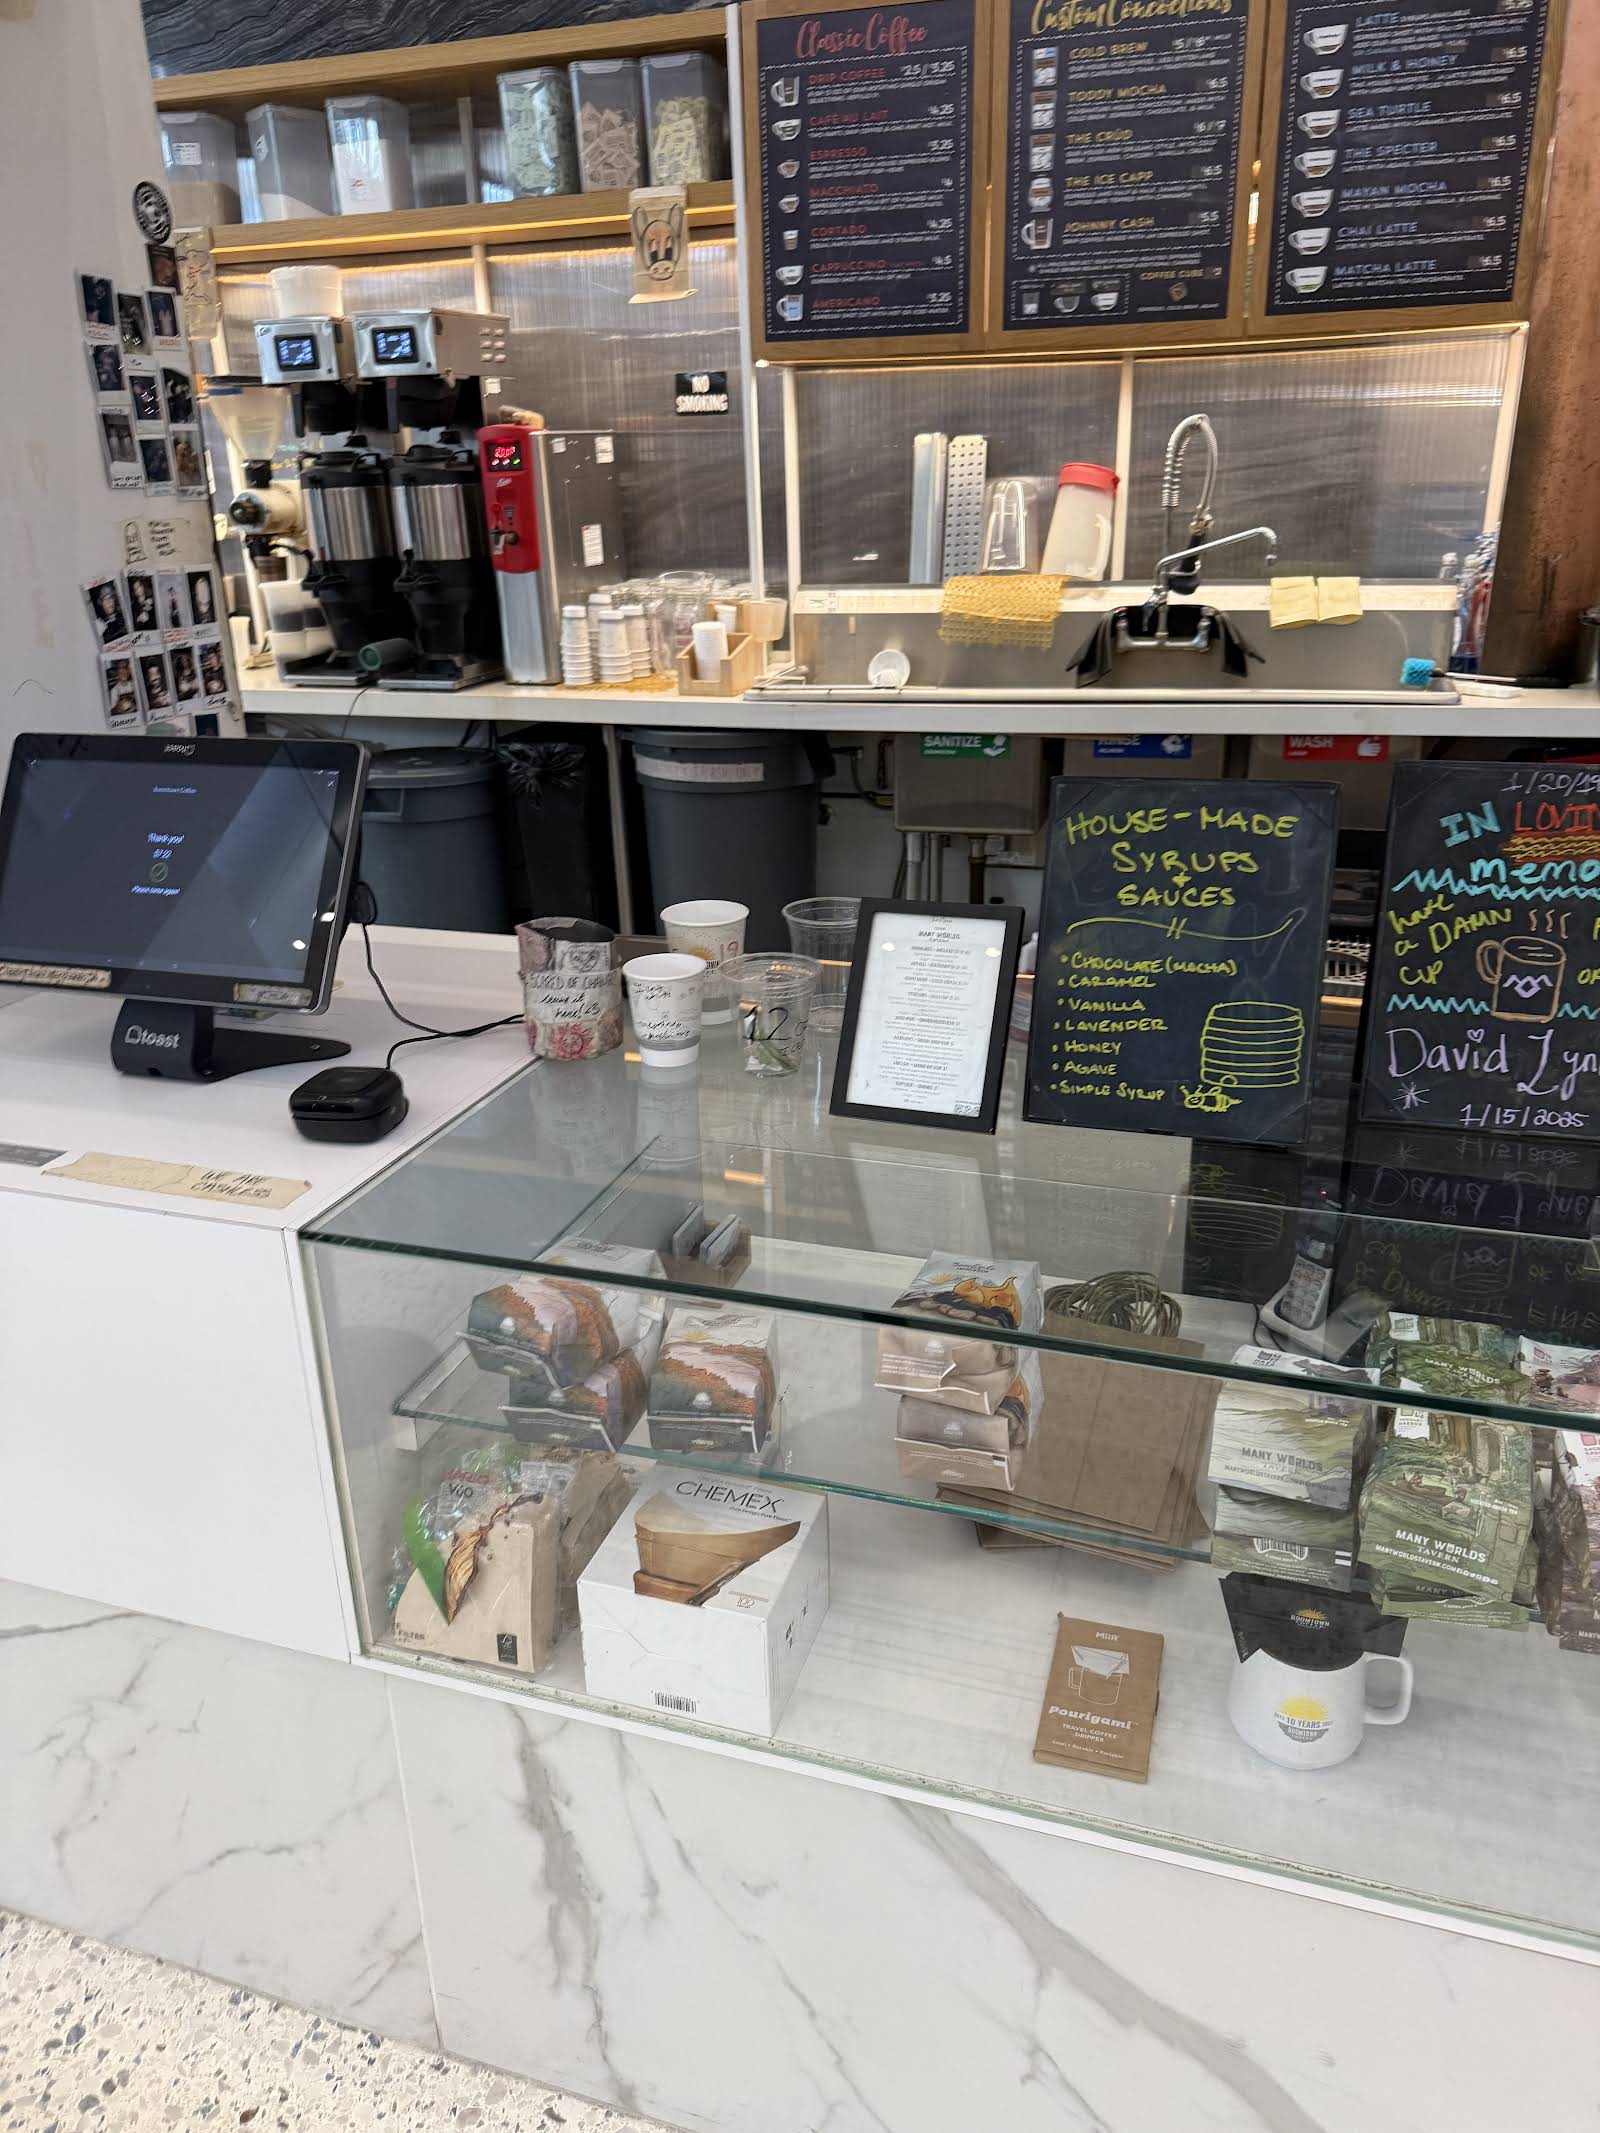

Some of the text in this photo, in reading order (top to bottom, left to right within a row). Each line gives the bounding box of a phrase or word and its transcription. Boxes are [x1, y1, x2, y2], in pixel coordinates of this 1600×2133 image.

[1356, 12, 1399, 26] LATTE
[795, 13, 928, 58] Classic Coffee
[692, 375, 710, 393] NO
[676, 394, 728, 412] SMOKING
[924, 735, 982, 747] SANITIZE
[1289, 735, 1334, 748] WASH
[1439, 800, 1501, 848] IN
[1111, 841, 1260, 873] SYRUPS
[1117, 883, 1237, 907] SAUCES
[1387, 893, 1455, 934] have
[1071, 951, 1164, 974] CHOCOLATE
[1068, 975, 1157, 989] CARAMEL
[1068, 999, 1146, 1012] VANILLA
[1065, 1018, 1169, 1032] LAVENDER
[141, 1028, 181, 1048] toast
[1064, 1040, 1122, 1056] HONEY
[1385, 1028, 1509, 1077] David
[1063, 1061, 1117, 1077] AGAVE
[1059, 1080, 1166, 1101] SIMPLE SYRUP
[1242, 1447, 1323, 1471] MANY WORLDS
[676, 1481, 781, 1513] CHEMEX
[1396, 1530, 1486, 1562] MANY WORLDS
[1417, 1546, 1459, 1563] TAVERN
[1298, 1719, 1320, 1729] YEARS
[1090, 1729, 1117, 1739] COFFEE
